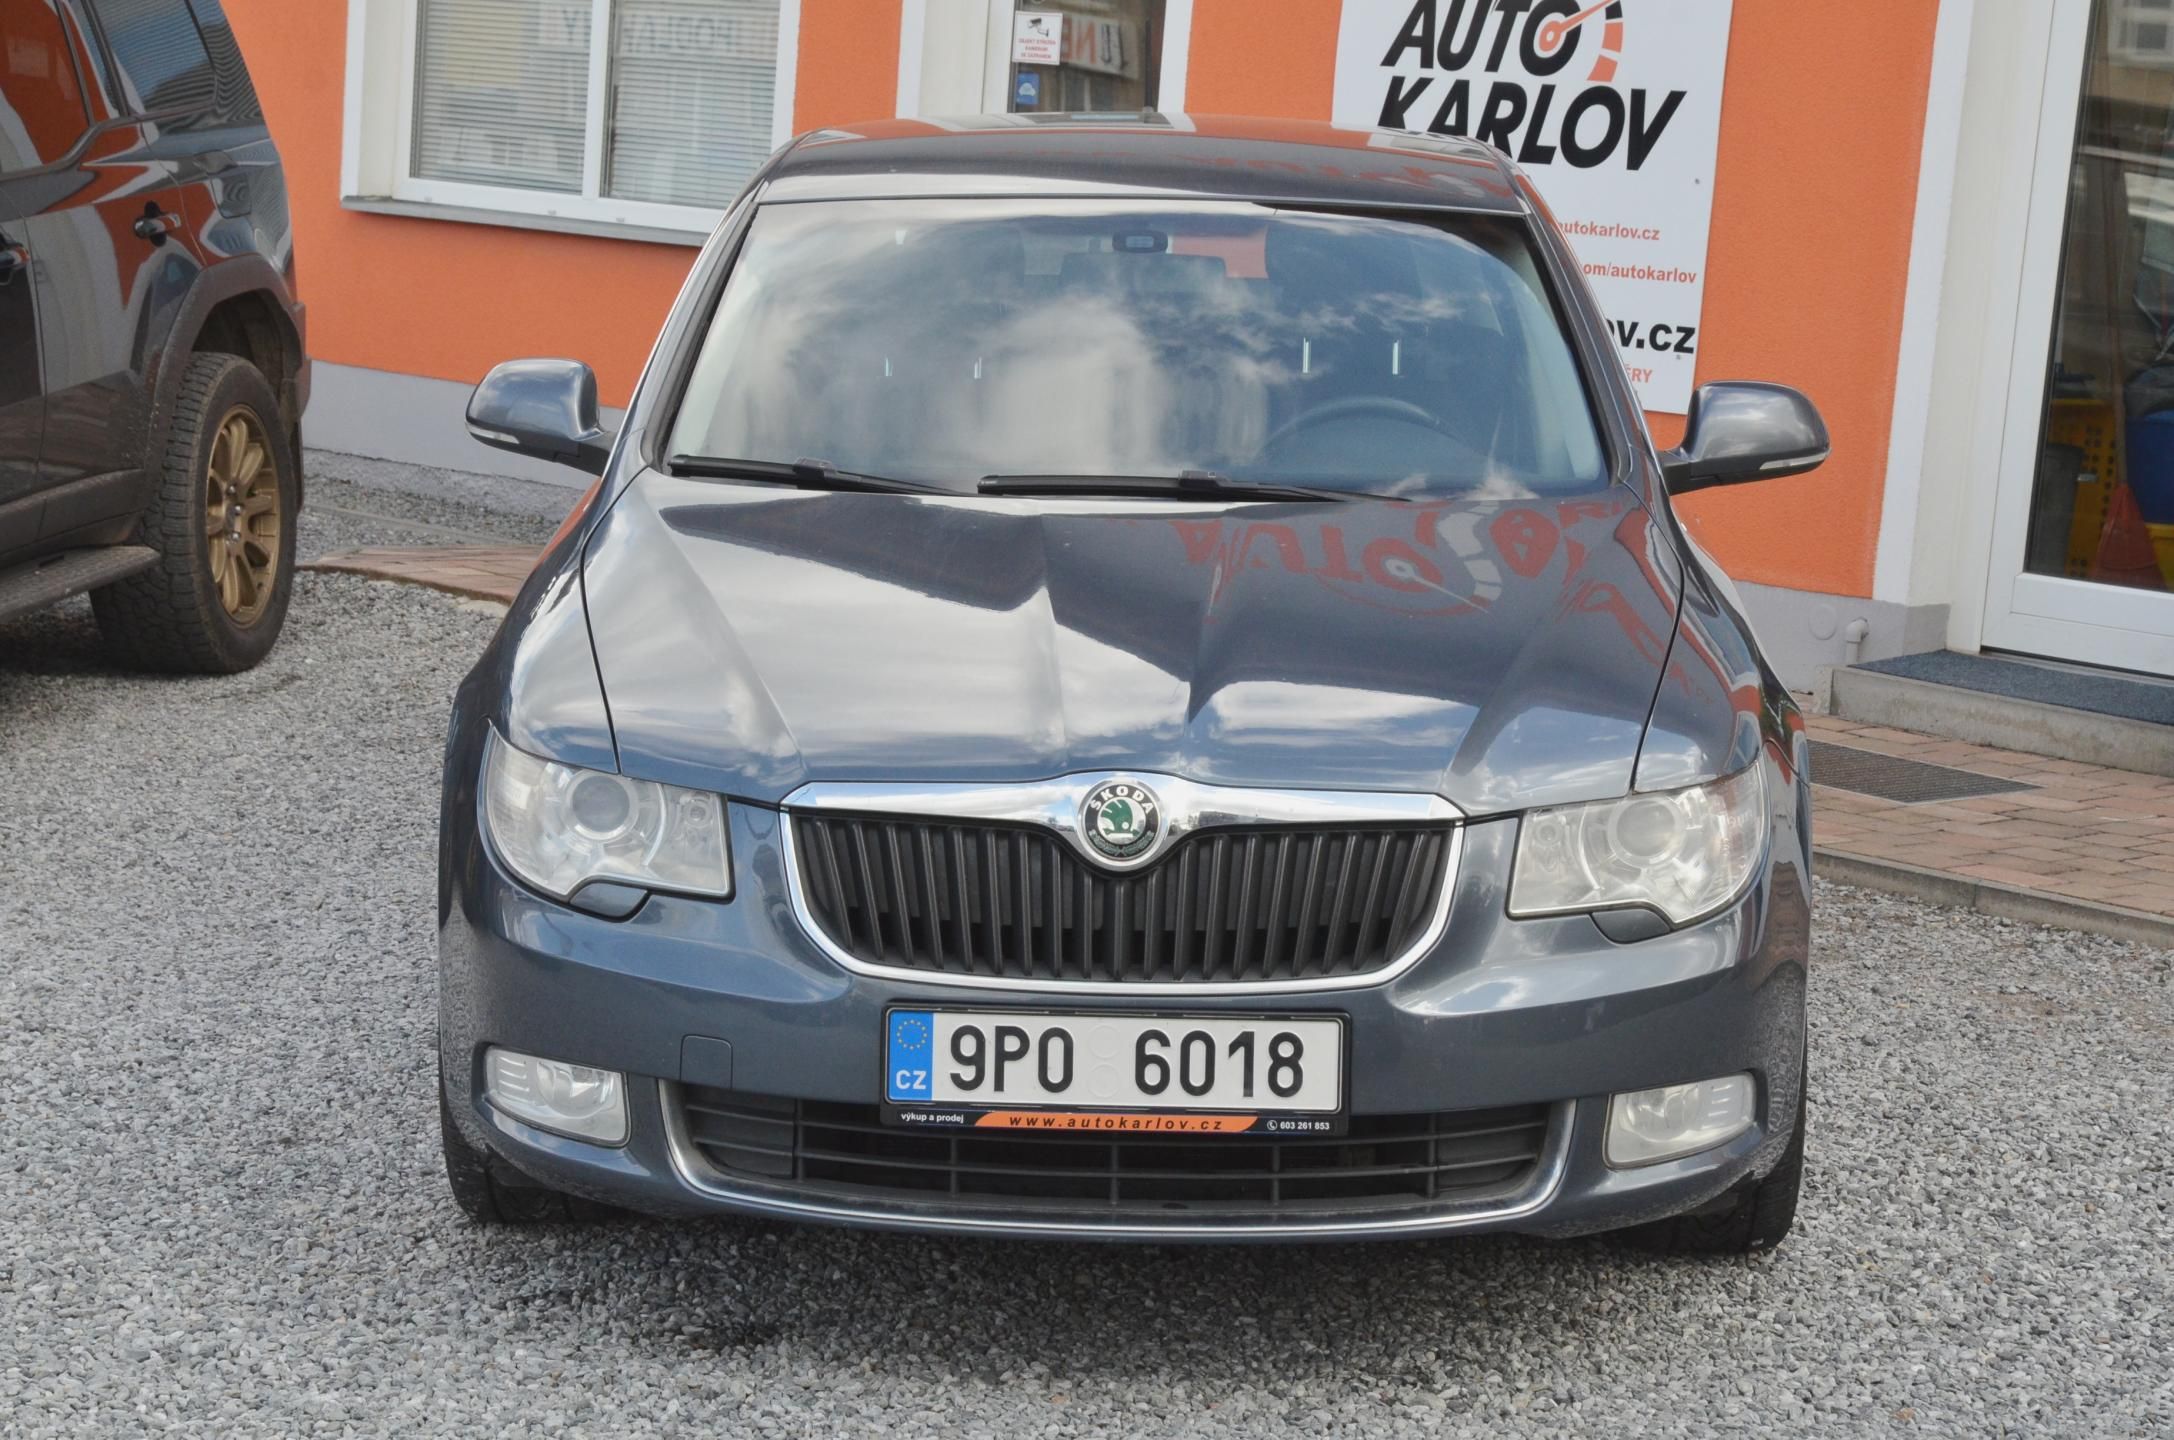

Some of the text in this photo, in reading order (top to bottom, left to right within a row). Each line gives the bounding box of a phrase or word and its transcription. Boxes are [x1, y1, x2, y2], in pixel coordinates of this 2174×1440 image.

[1380, 0, 1582, 77] AUTO
[1377, 75, 1688, 171] KARLOV
[1583, 261, 1697, 283] om/autokarlov
[895, 1069, 927, 1090] CZ
[949, 1024, 1304, 1099] 9P0 6018
[900, 1111, 928, 1123] výkup
[928, 1113, 935, 1121] a
[936, 1113, 964, 1124] prodej
[1009, 1115, 1223, 1131] www.autokarlov.cz
[1280, 1120, 1296, 1130] 603
[1297, 1121, 1313, 1131] 261
